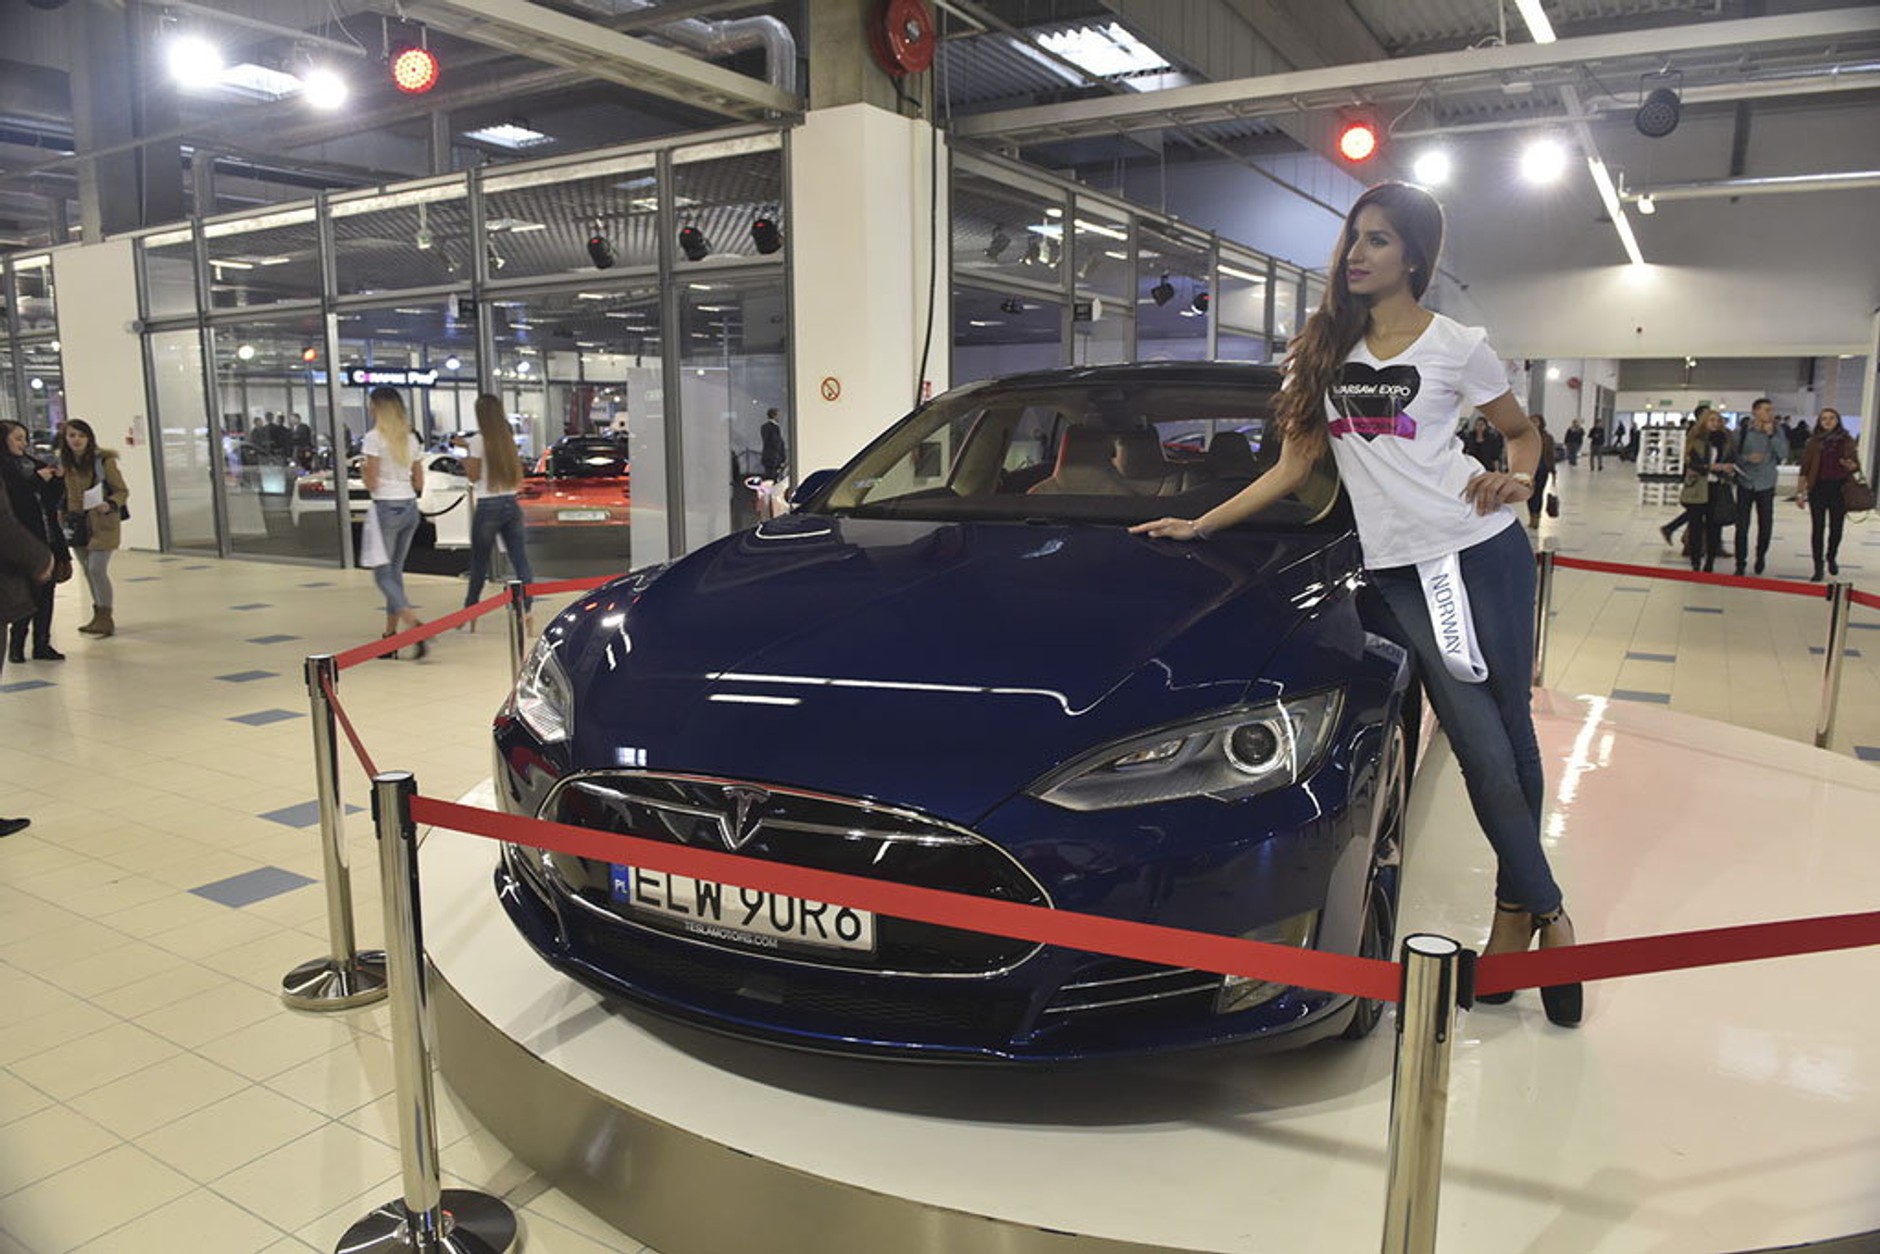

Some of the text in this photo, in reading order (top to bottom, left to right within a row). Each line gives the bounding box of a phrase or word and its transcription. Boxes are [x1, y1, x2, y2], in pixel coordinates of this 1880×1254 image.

[1379, 383, 1411, 397] EXPO
[1430, 572, 1462, 655] NORWAY
[635, 866, 722, 921] ELW
